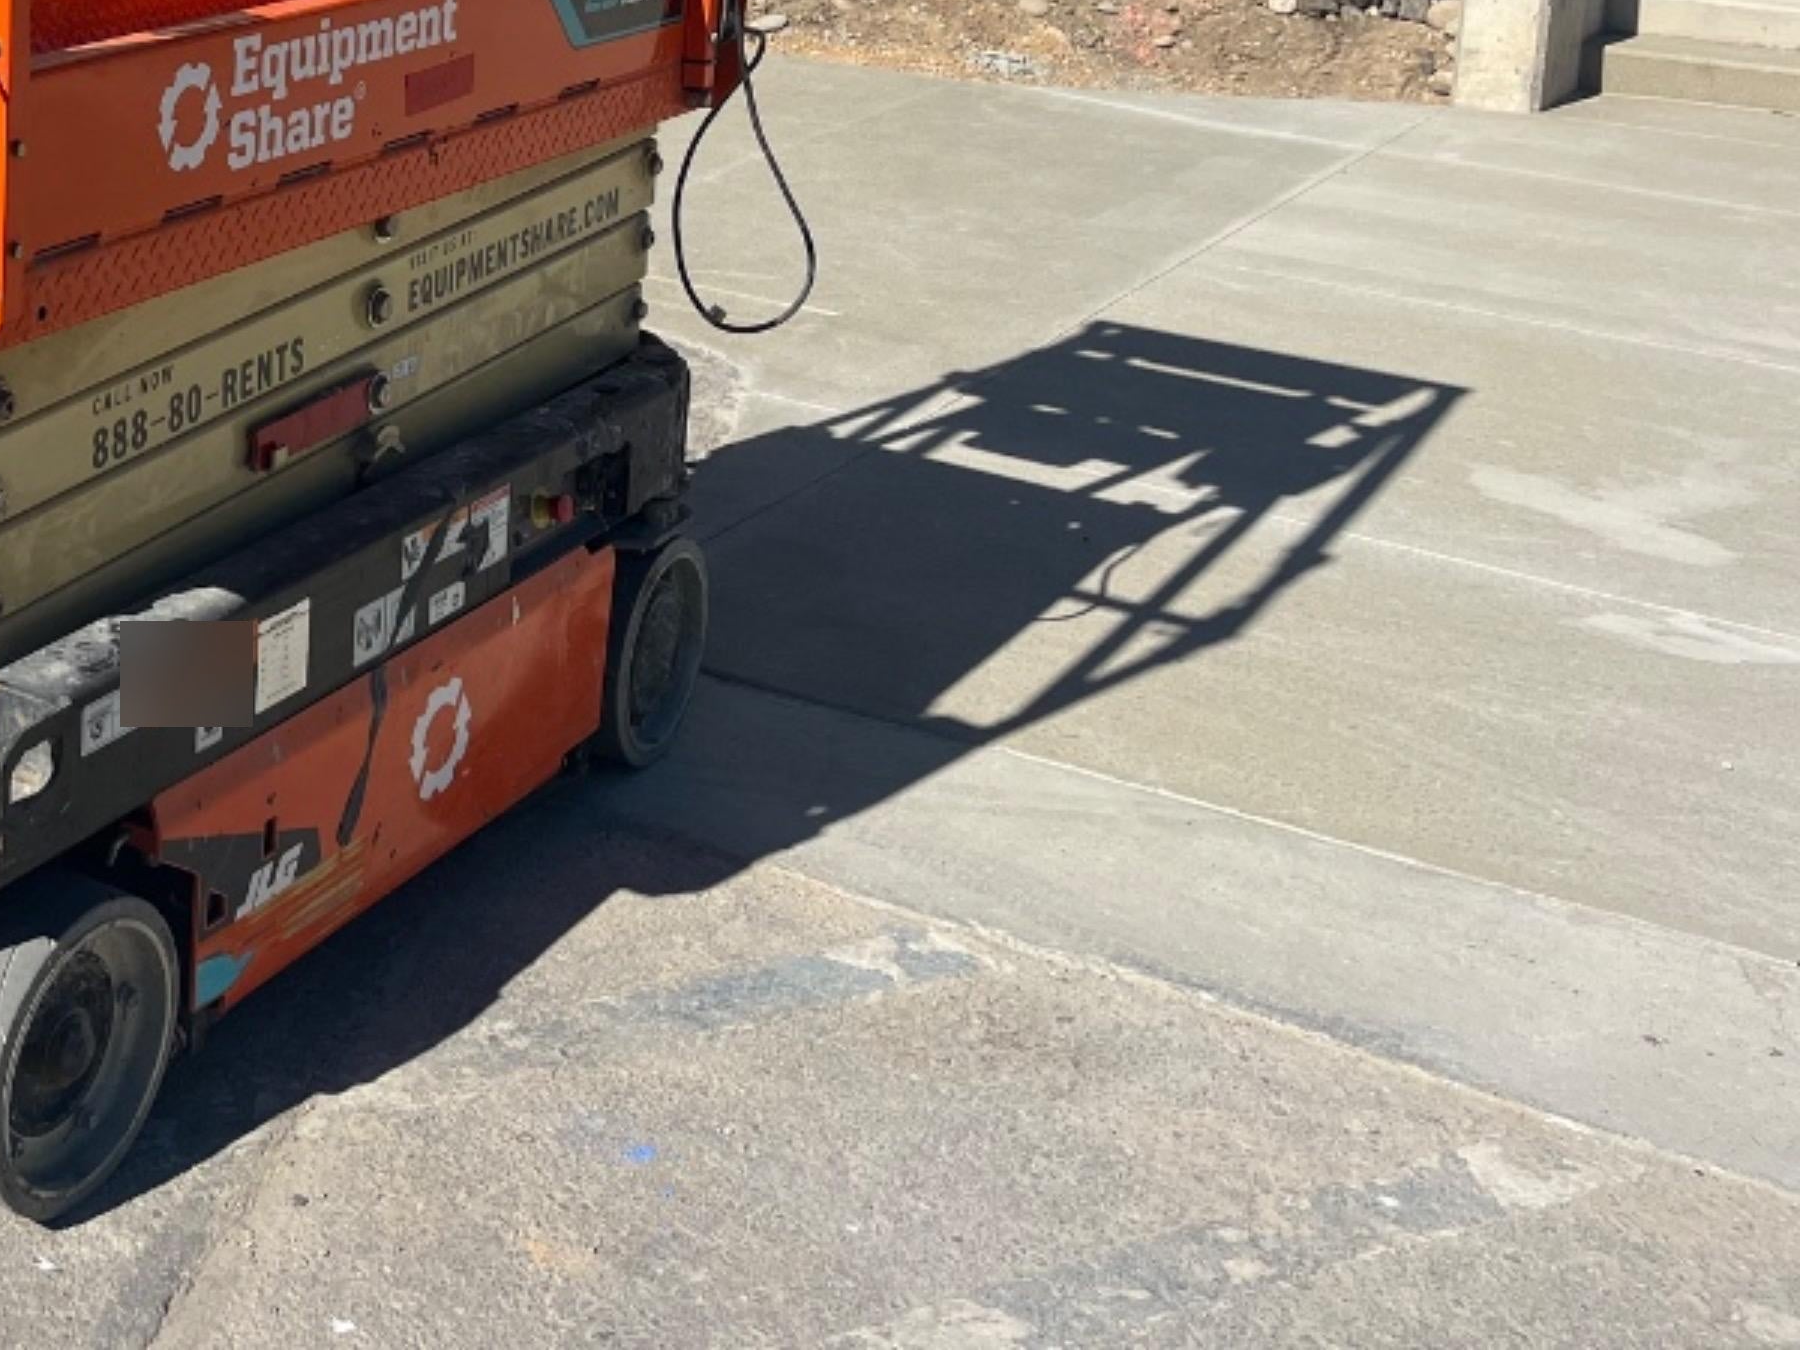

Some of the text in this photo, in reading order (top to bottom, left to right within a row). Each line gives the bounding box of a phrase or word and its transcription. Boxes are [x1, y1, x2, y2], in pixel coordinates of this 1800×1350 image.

[227, 95, 356, 170] Share
[408, 187, 620, 312] EQUIPMENTSHARE.COM
[92, 336, 304, 469] 888-80-RENTS
[93, 365, 175, 415] CALL NOW
[234, 841, 304, 921] JLG
